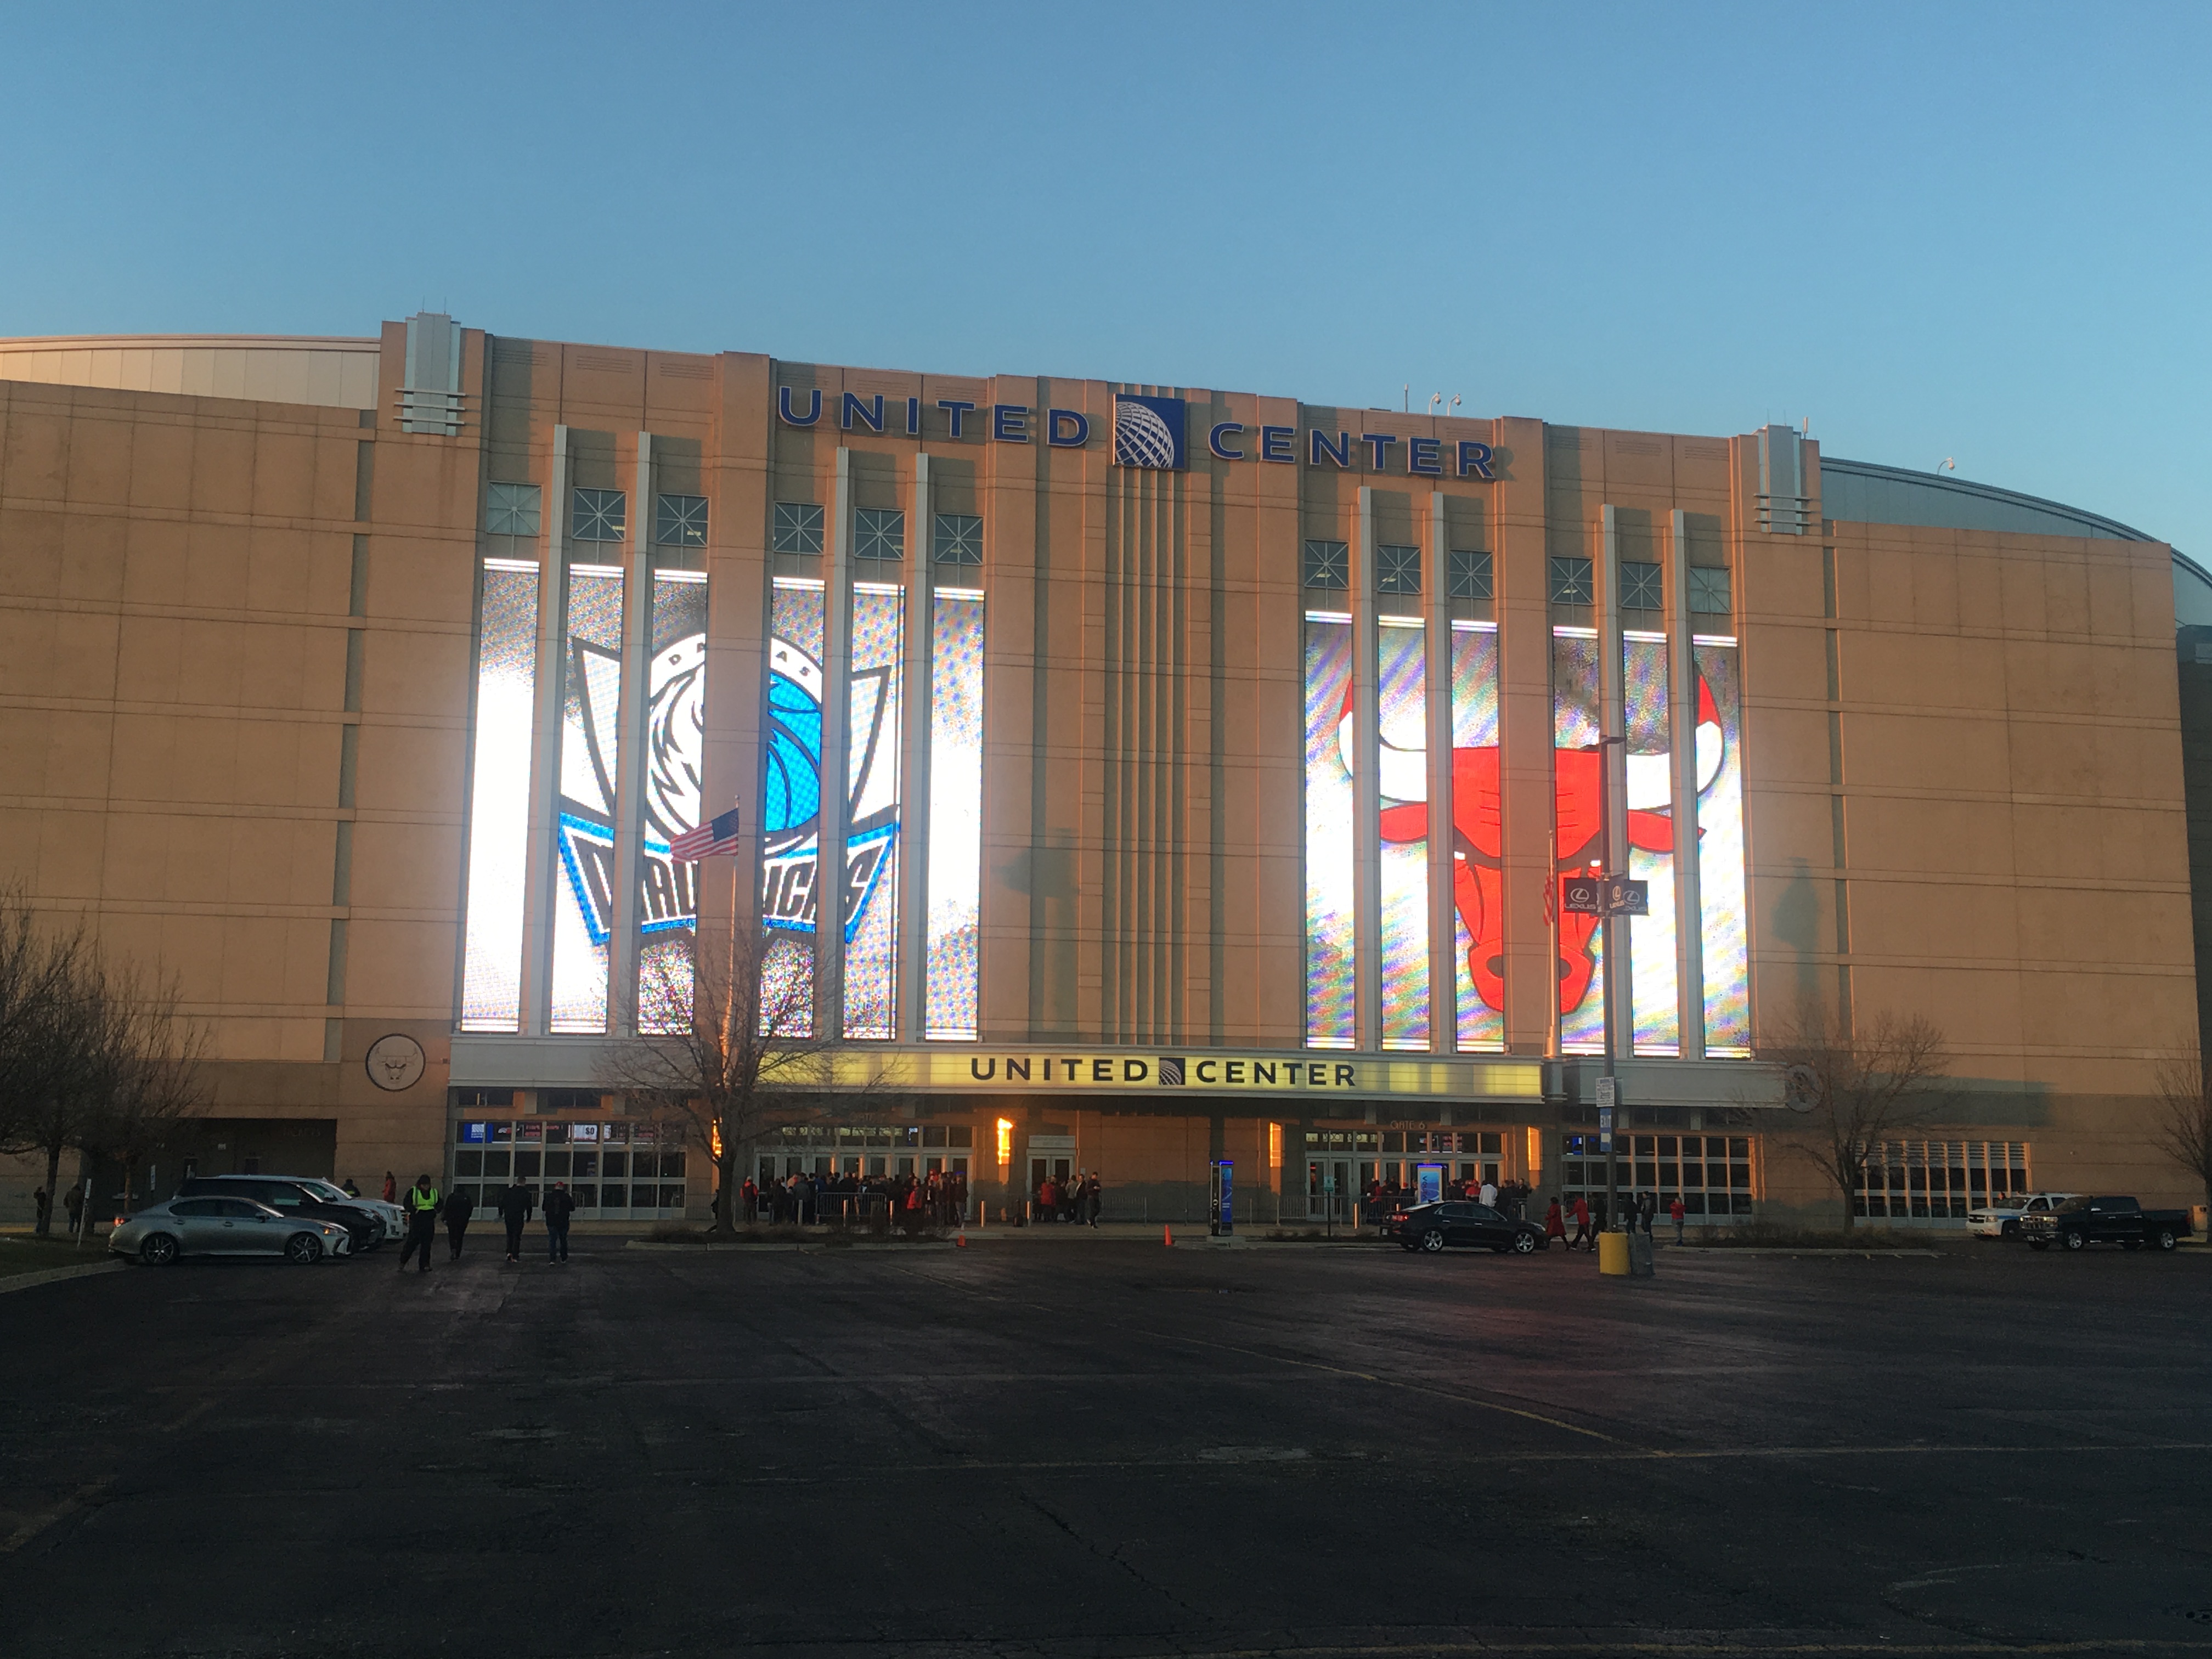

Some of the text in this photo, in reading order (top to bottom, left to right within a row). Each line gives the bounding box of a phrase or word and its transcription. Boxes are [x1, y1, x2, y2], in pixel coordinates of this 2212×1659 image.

[778, 386, 1496, 478] UNITED CENTER
[971, 1058, 1356, 1087] UNITED CENTER
[1390, 1120, 1425, 1129] GATE 6
